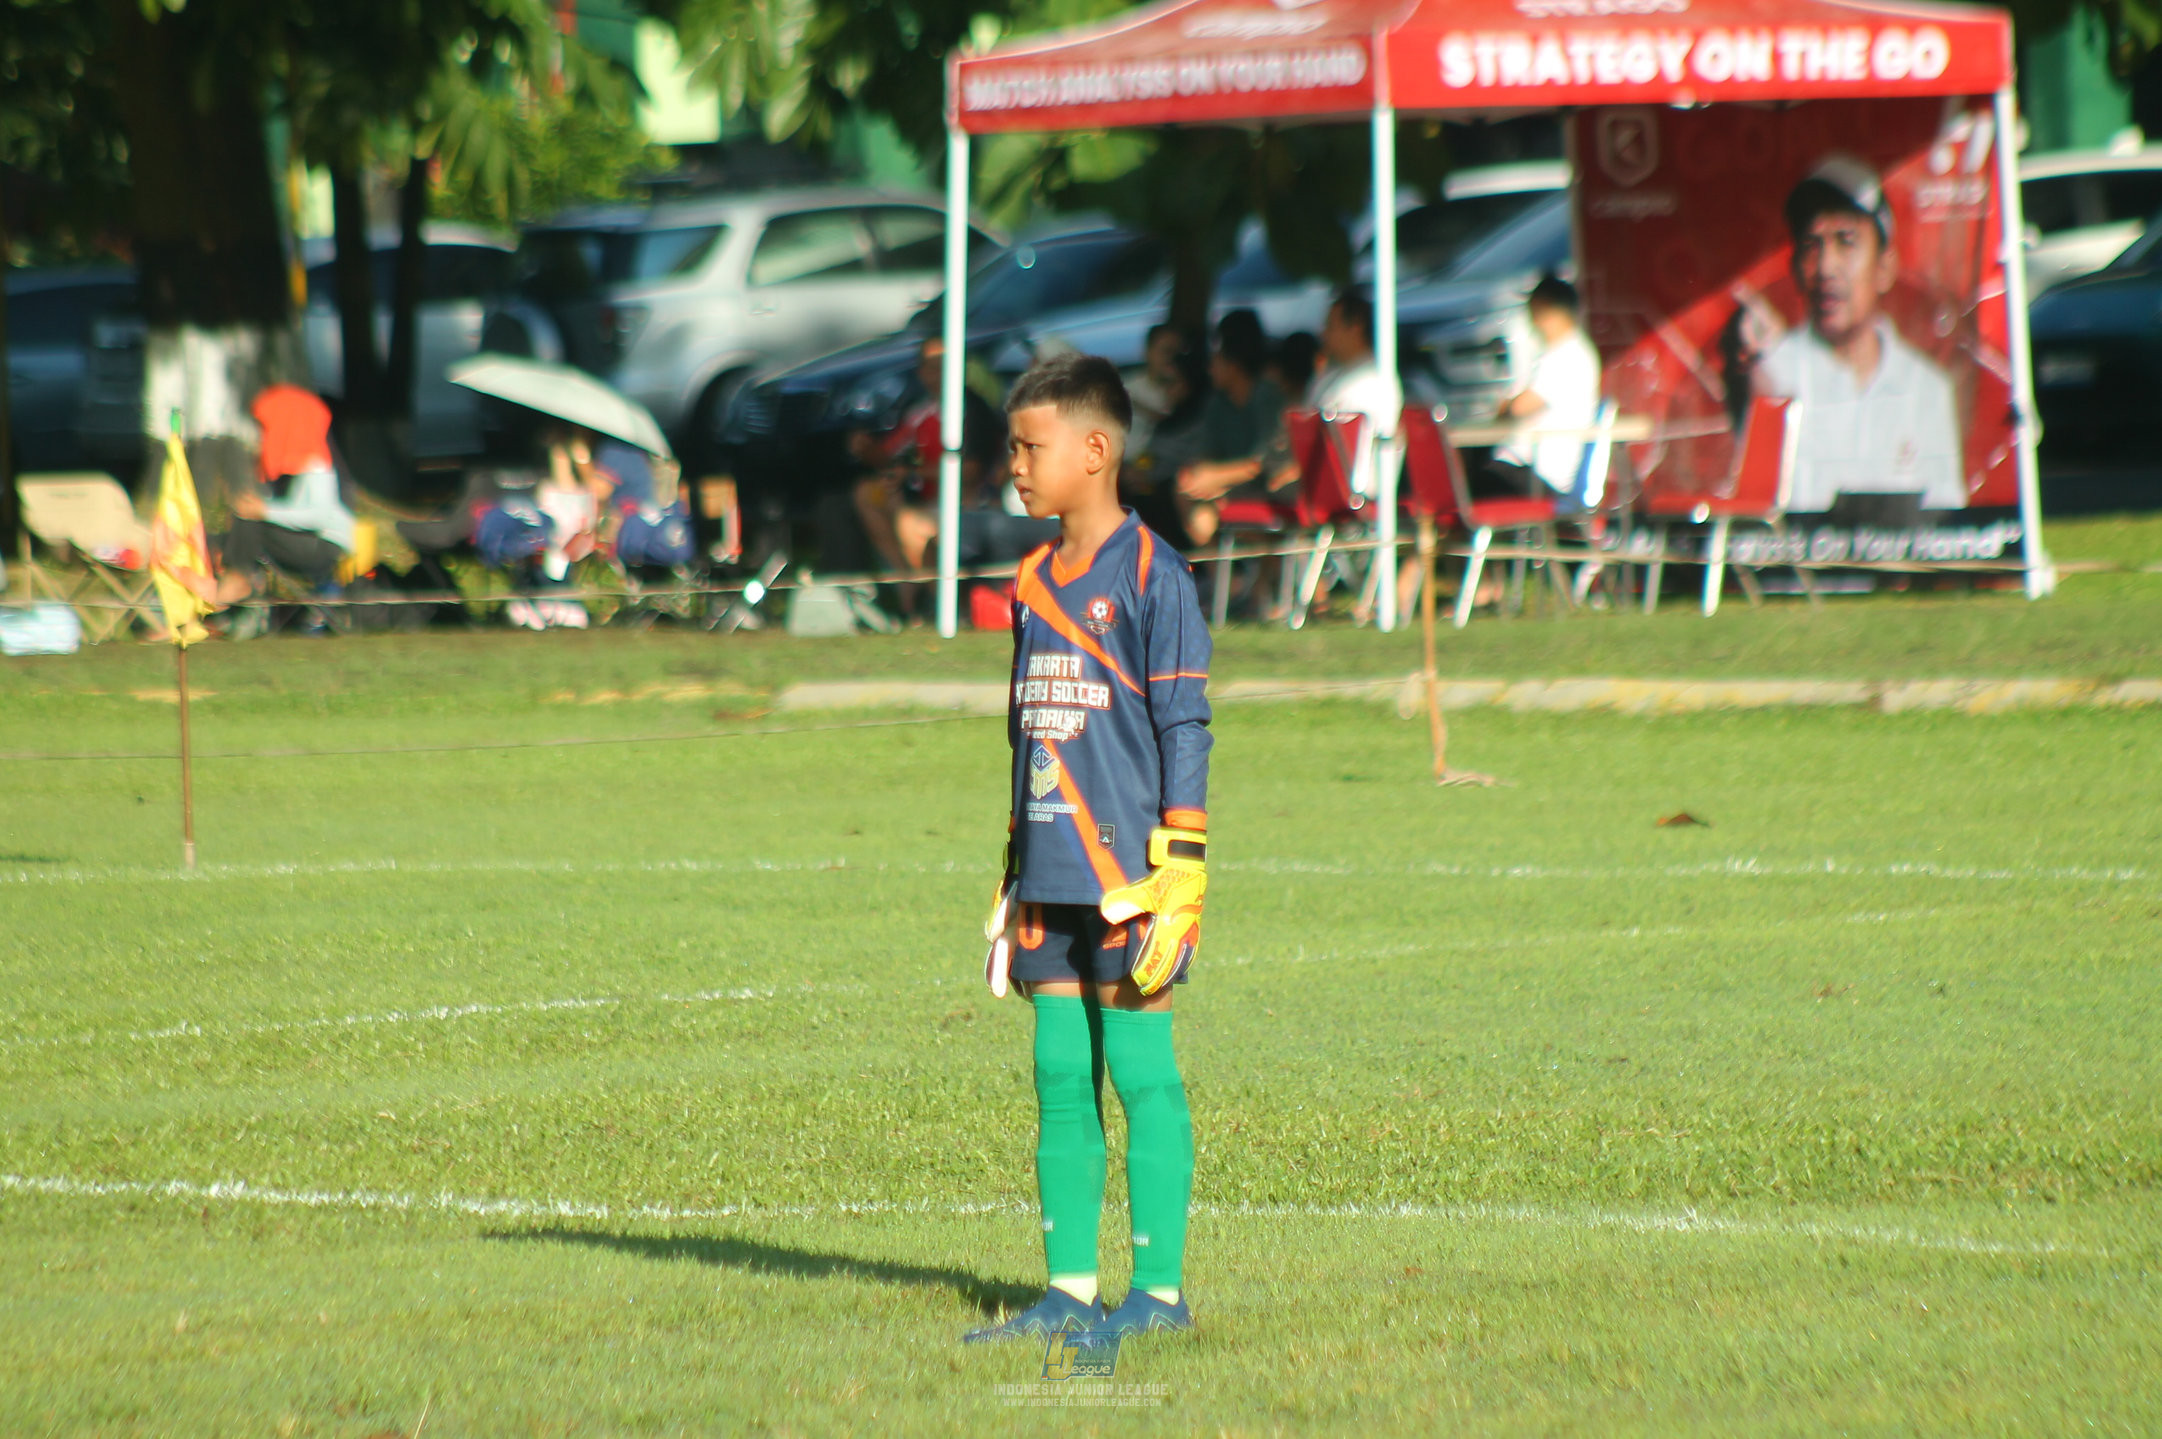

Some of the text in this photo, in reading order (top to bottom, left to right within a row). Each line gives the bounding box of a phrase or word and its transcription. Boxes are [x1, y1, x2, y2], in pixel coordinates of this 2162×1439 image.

[1439, 25, 1950, 87] STRATEGY ON THE GO
[1051, 681, 1110, 708] SOCCER
